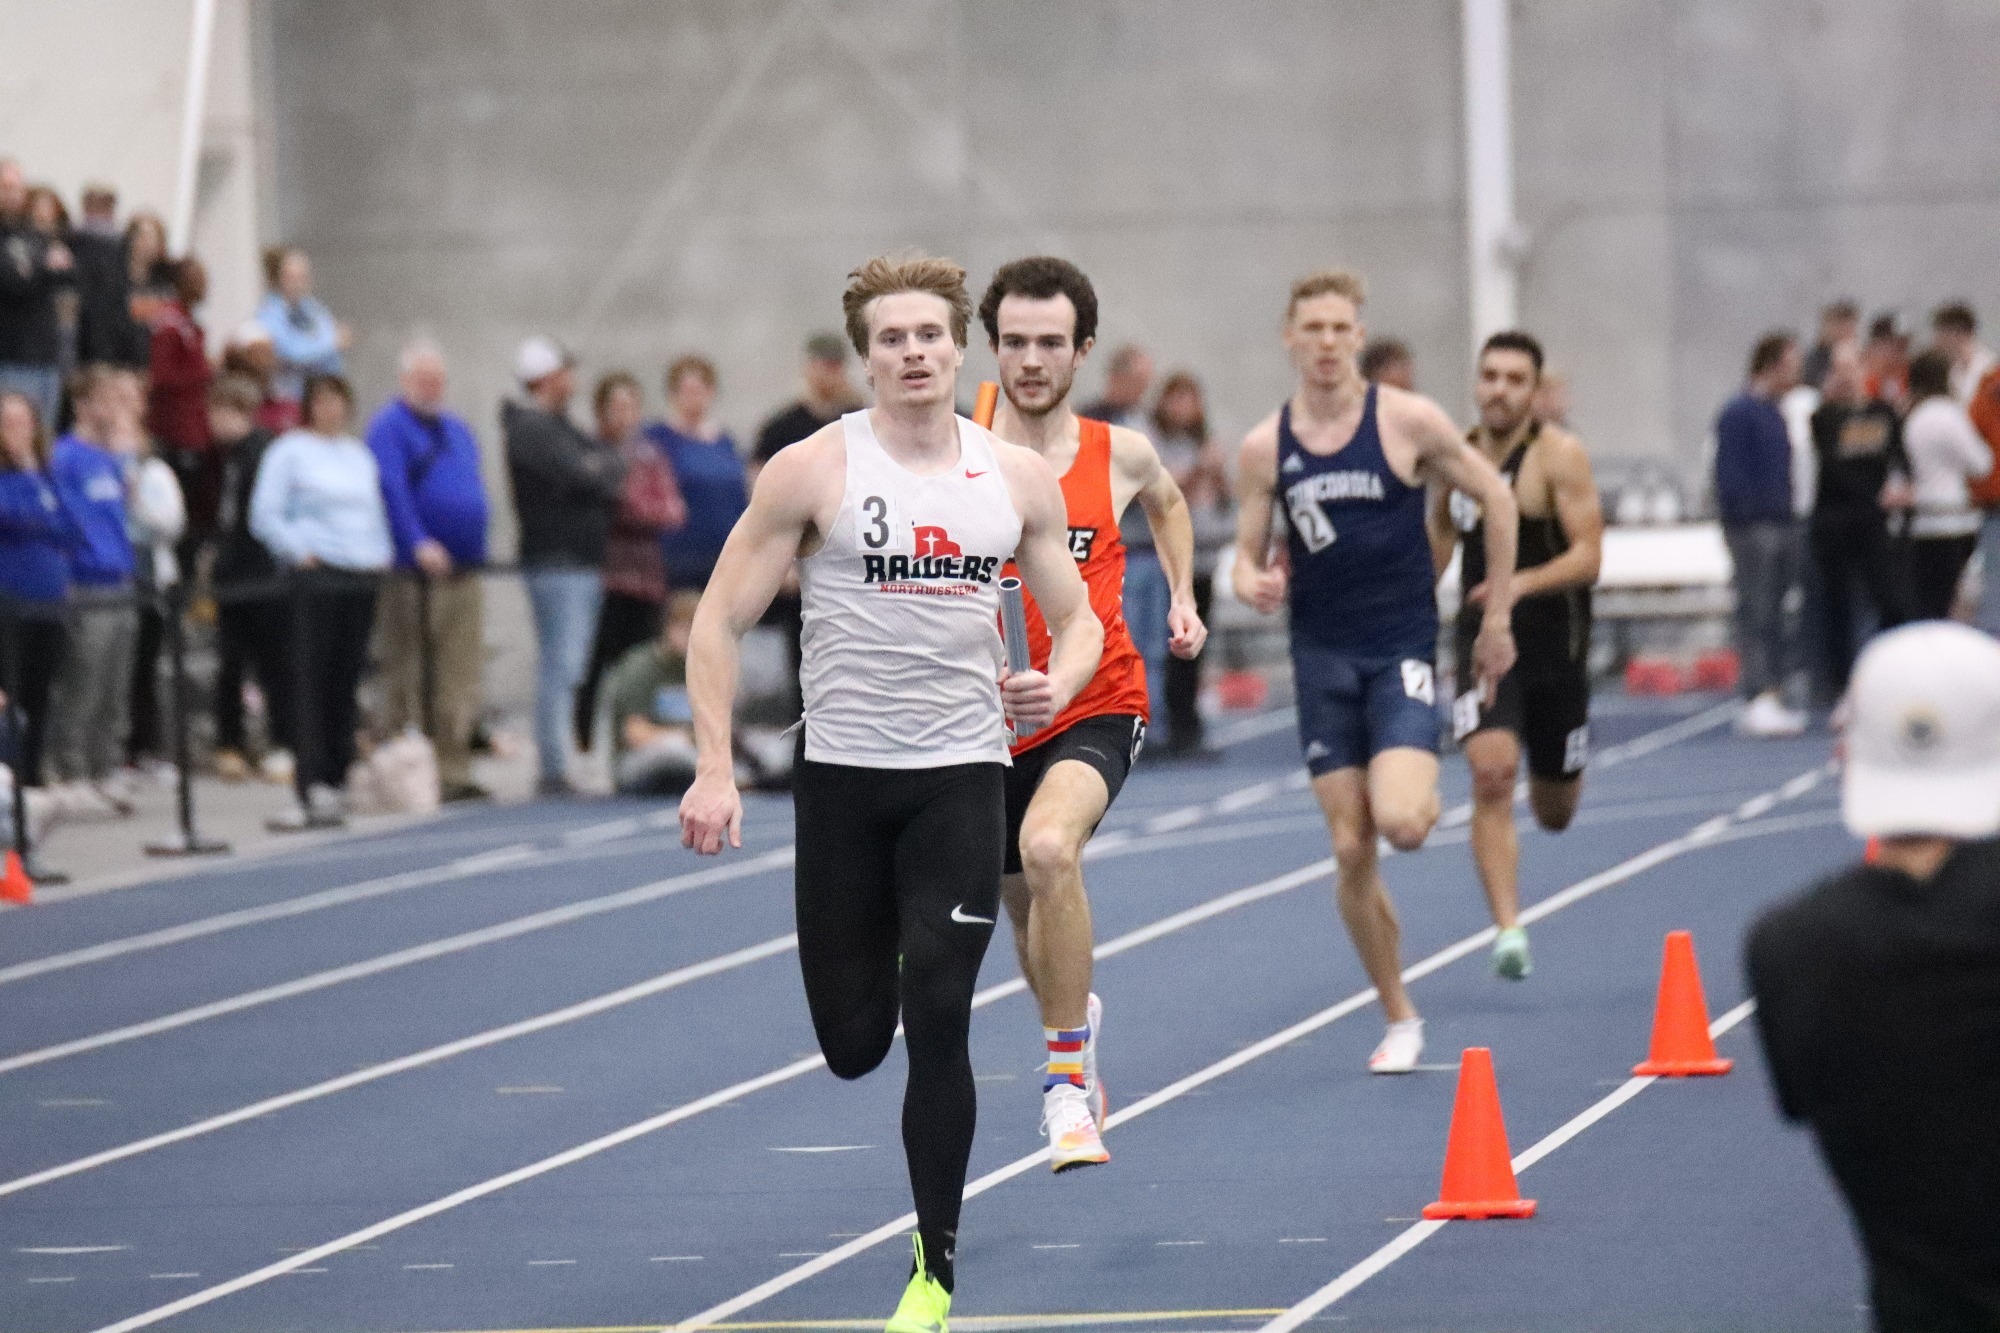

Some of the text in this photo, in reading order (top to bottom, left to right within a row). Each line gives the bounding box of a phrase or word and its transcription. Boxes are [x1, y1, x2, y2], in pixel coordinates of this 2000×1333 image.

[862, 495, 890, 549] 3
[1298, 510, 1328, 544] 2
[863, 554, 999, 584] RAIDERS
[879, 583, 979, 597] NORTHWESTERN
